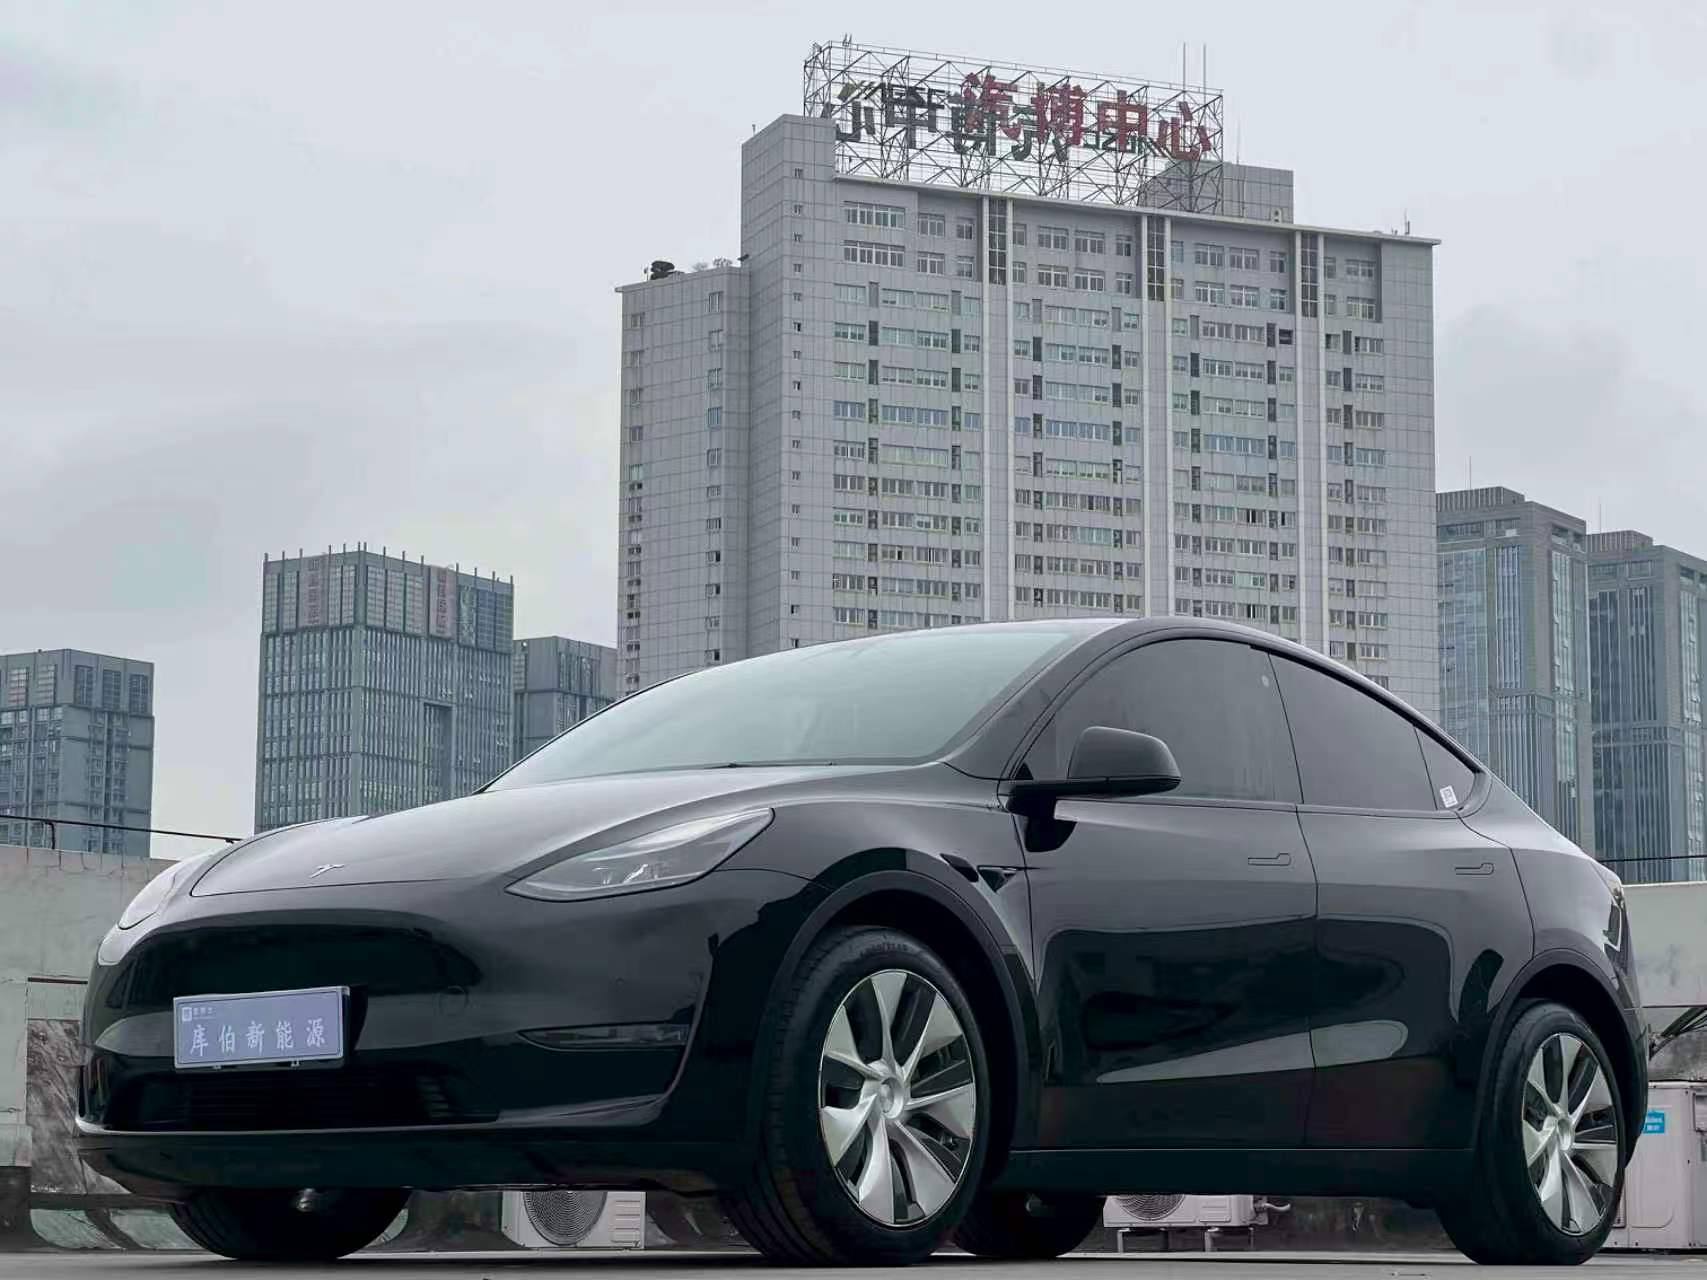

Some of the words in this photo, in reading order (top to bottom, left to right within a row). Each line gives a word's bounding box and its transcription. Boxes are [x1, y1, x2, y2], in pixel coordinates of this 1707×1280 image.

[964, 72, 1212, 161] 汽博中心
[190, 1018, 326, 1057] 库伯新能源
